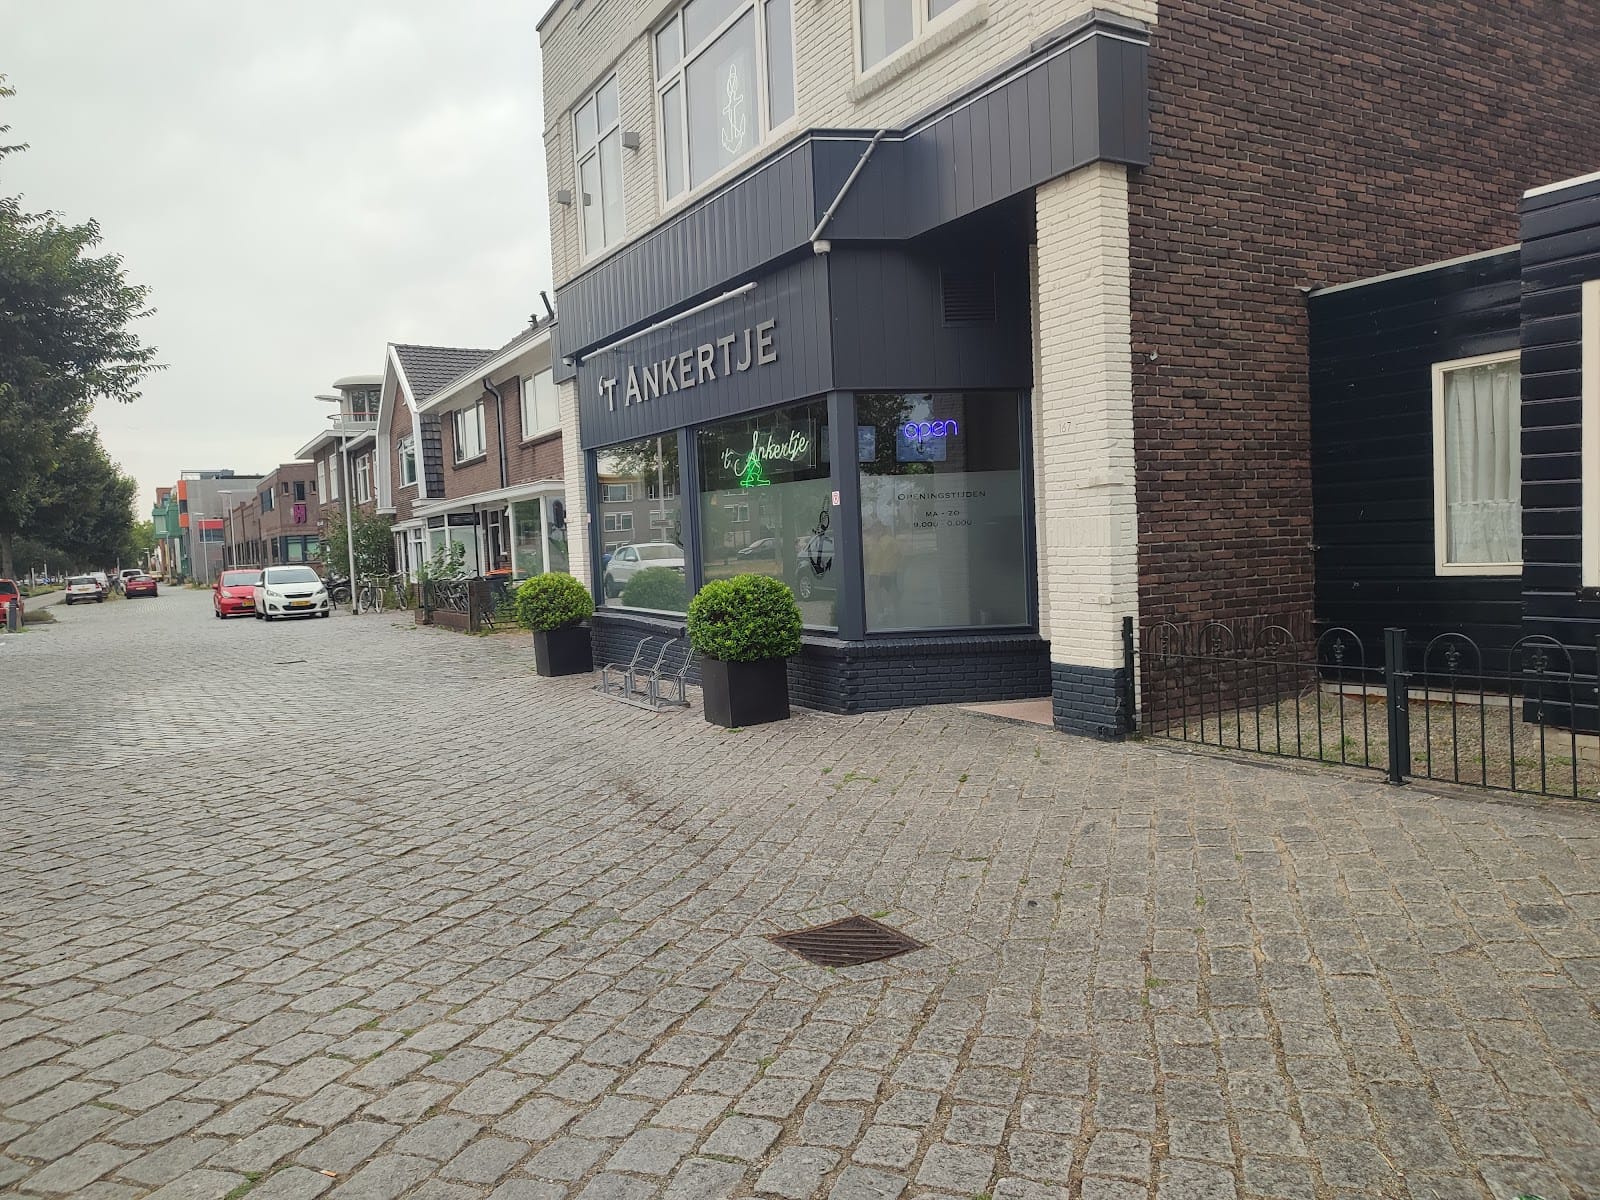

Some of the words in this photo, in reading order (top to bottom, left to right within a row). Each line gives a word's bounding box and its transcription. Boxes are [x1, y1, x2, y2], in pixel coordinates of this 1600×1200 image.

[625, 317, 777, 407] ANKERTJE
[734, 430, 809, 477] Ankertje
[904, 419, 958, 443] open
